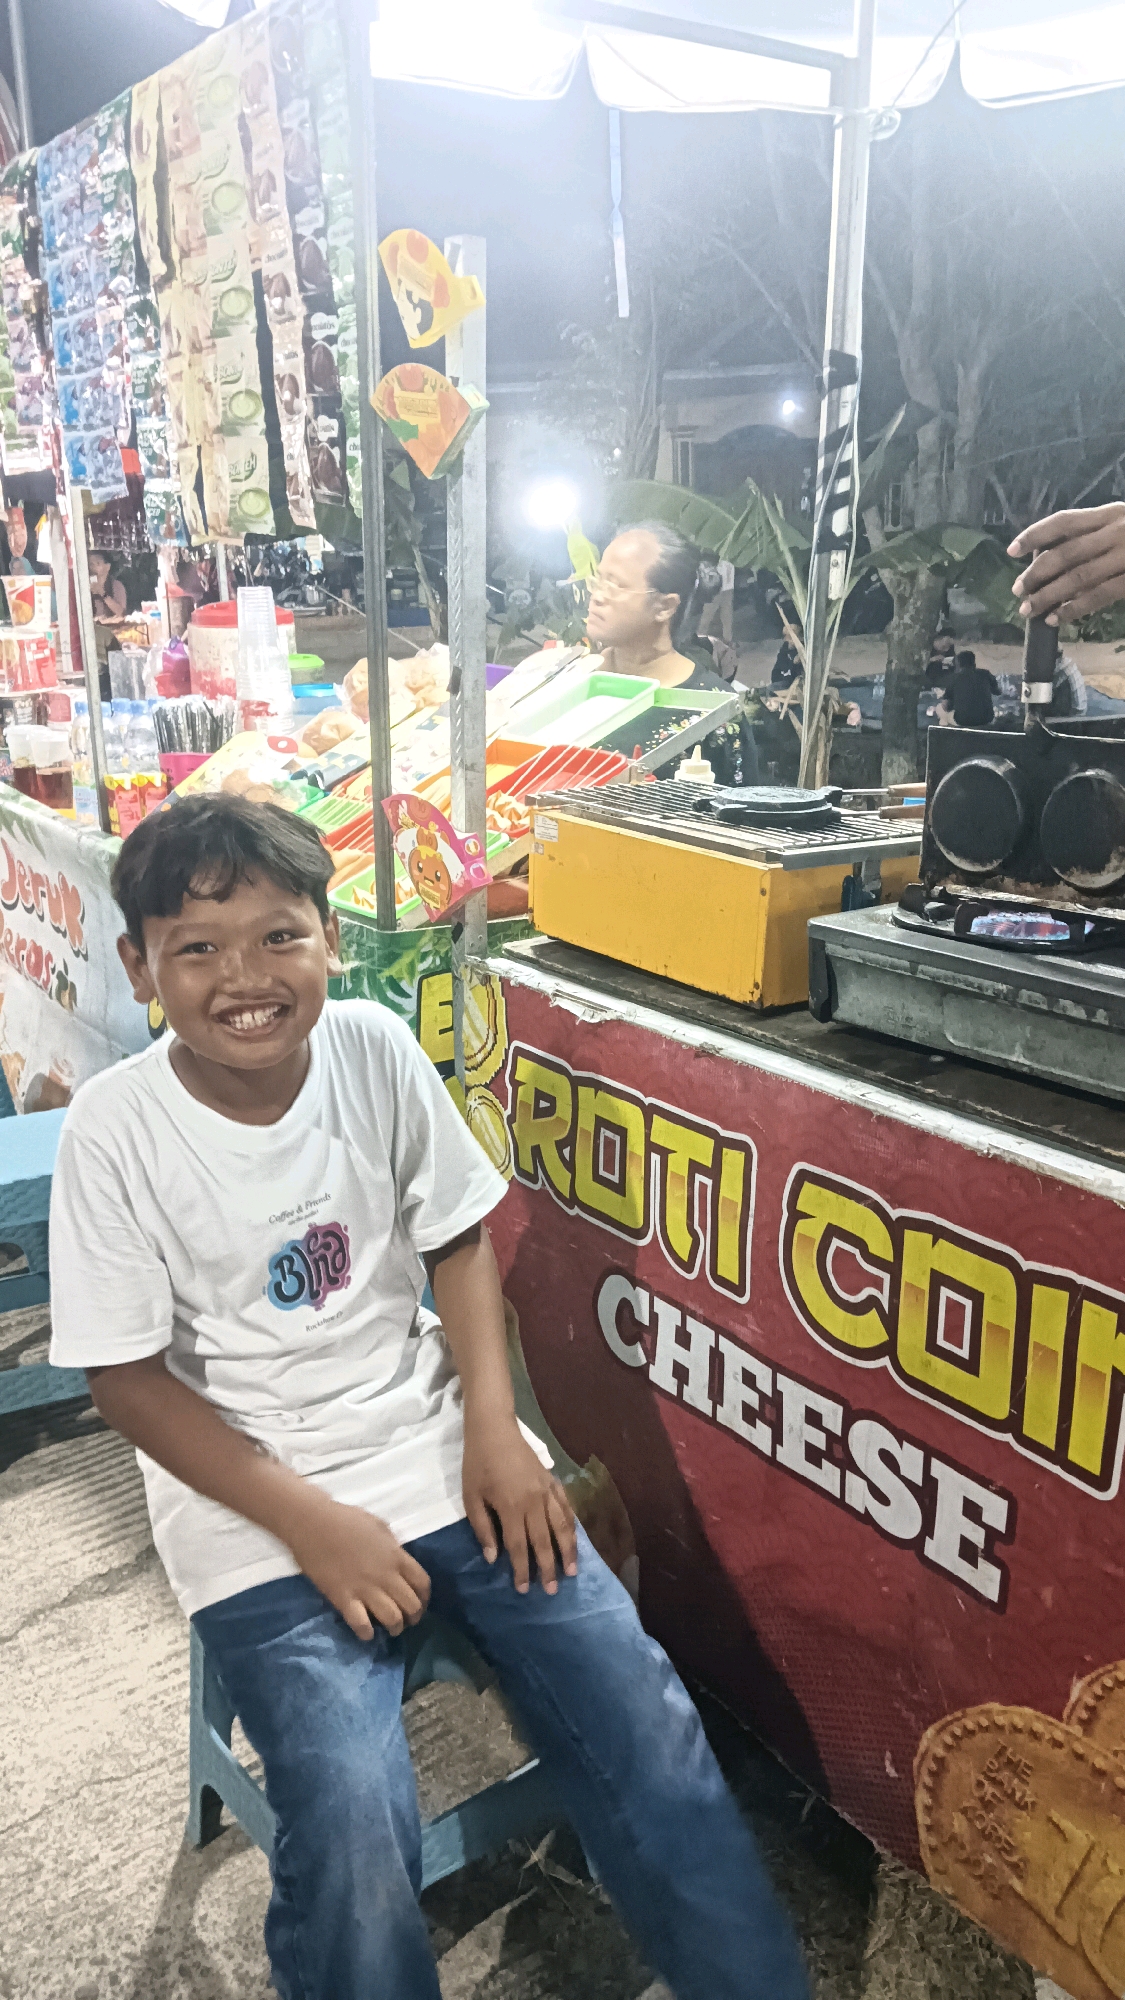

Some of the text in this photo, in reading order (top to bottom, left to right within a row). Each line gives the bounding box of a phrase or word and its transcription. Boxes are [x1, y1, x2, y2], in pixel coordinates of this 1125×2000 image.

[0, 908, 53, 991] eras
[1, 837, 84, 950] Jeruk
[269, 1209, 295, 1224] Coffee
[305, 1192, 332, 1211] Friends
[514, 1055, 748, 1287] ROTI
[598, 1274, 1008, 1603] CHEESE
